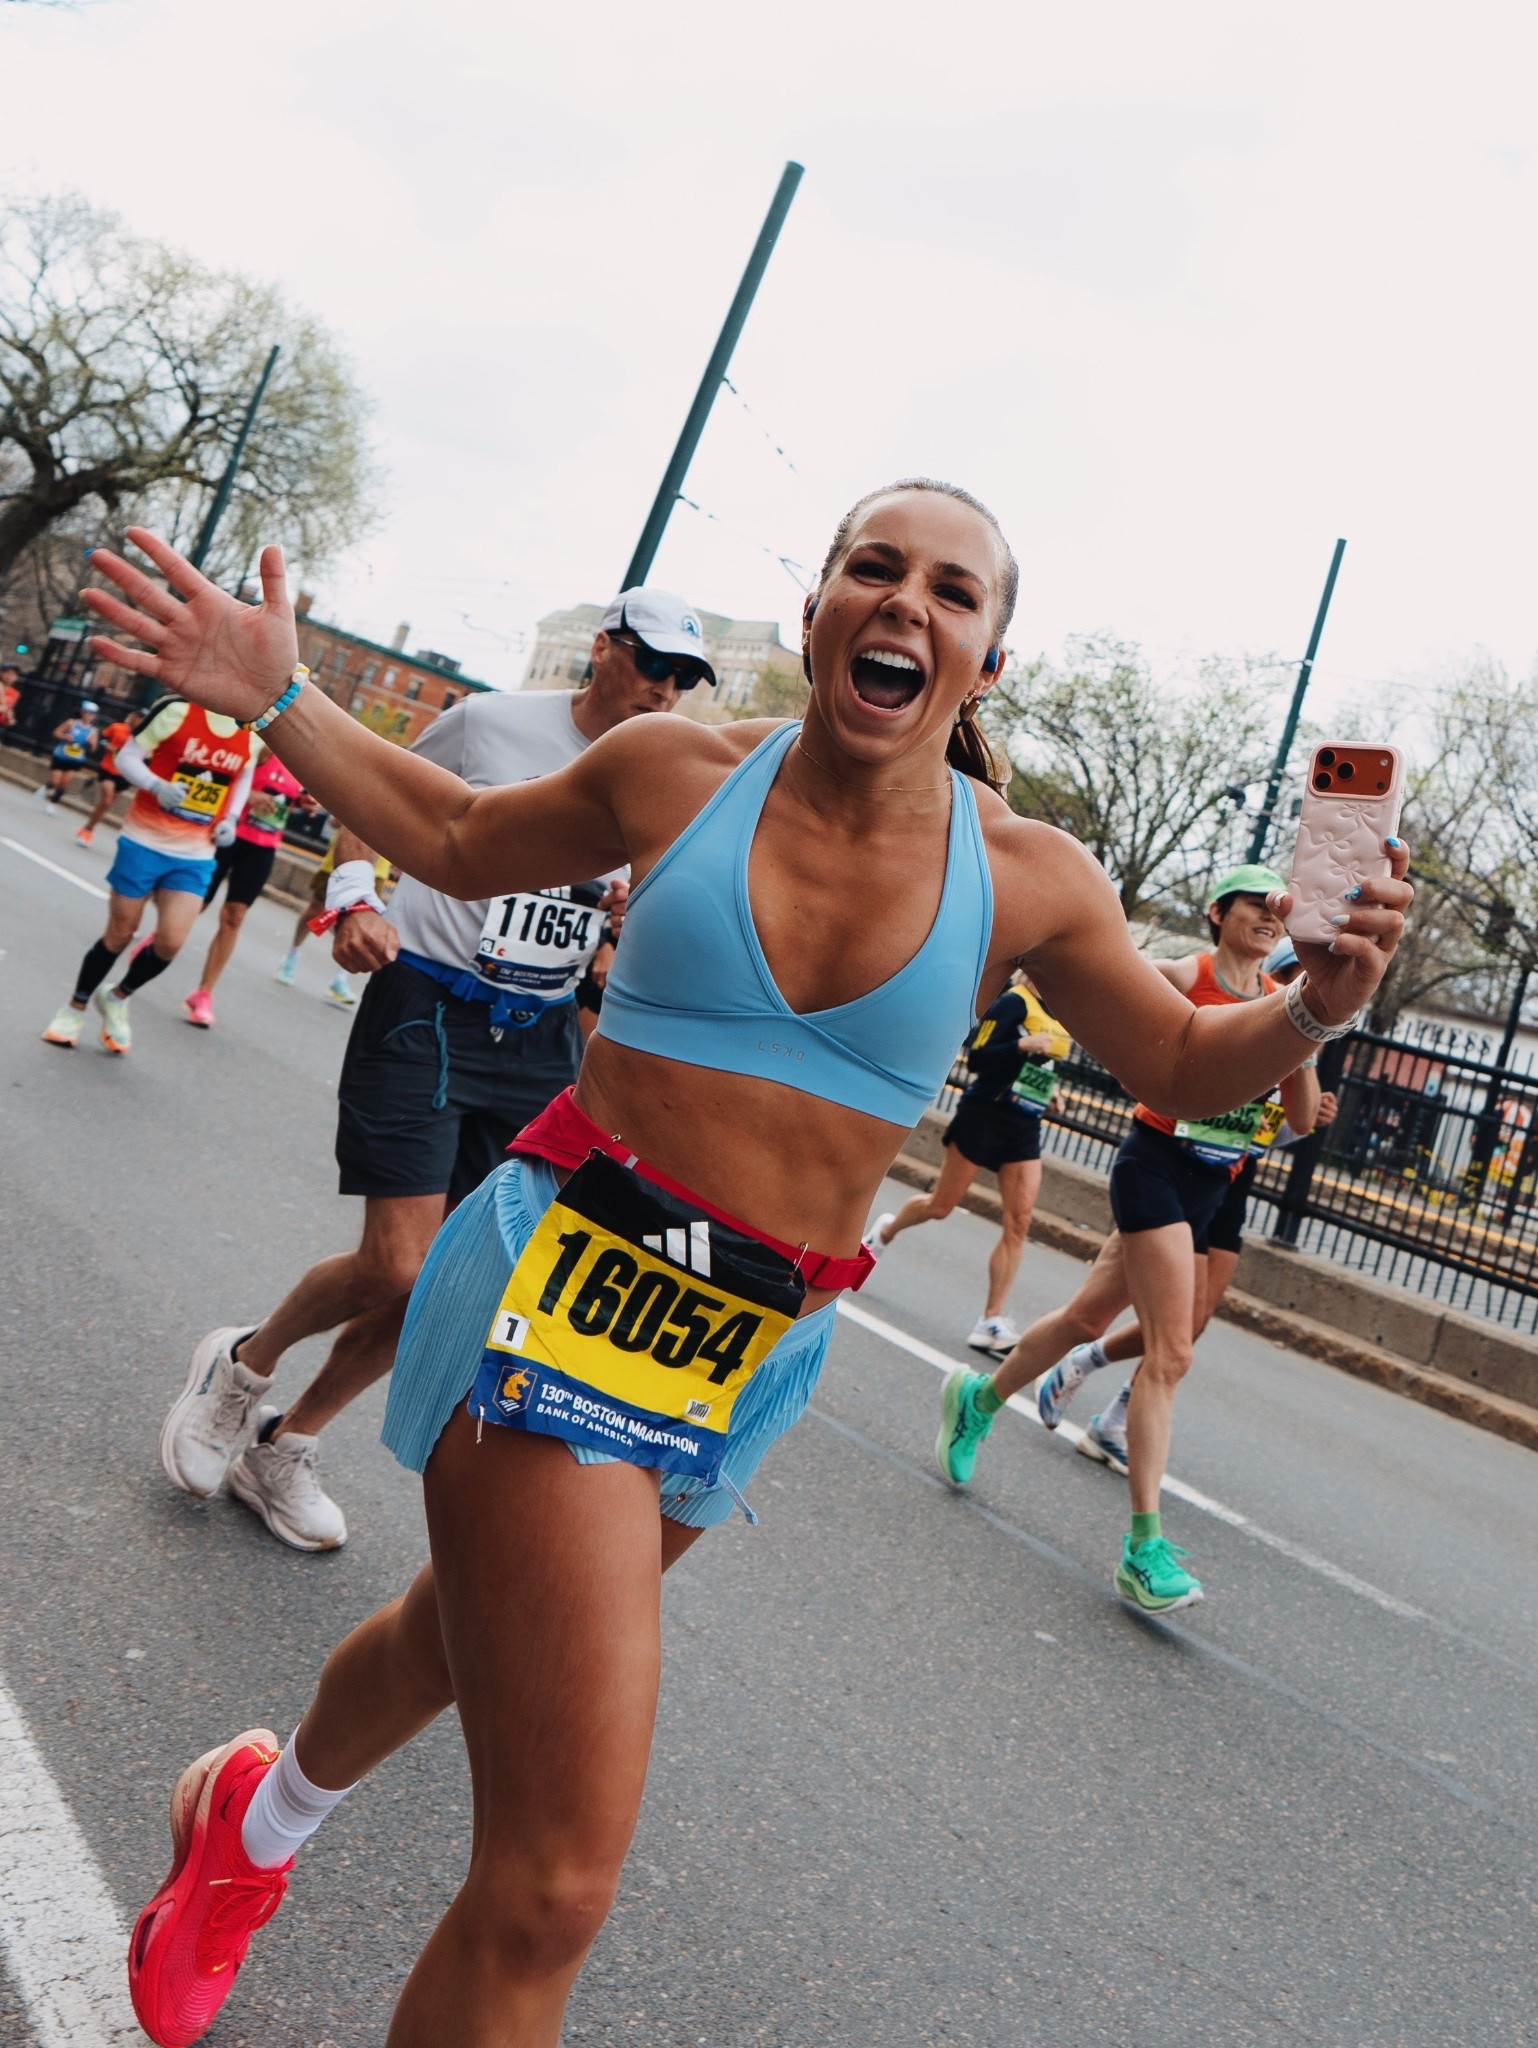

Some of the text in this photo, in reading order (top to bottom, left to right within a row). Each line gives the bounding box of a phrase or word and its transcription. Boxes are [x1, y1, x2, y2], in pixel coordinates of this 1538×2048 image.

[498, 896, 592, 950] 11654
[505, 1316, 519, 1342] 1
[537, 1230, 764, 1386] 16054
[536, 1404, 633, 1447] BANK OF AMERICA
[573, 1396, 626, 1430] BOSTON
[627, 1419, 699, 1456] MARATHON
